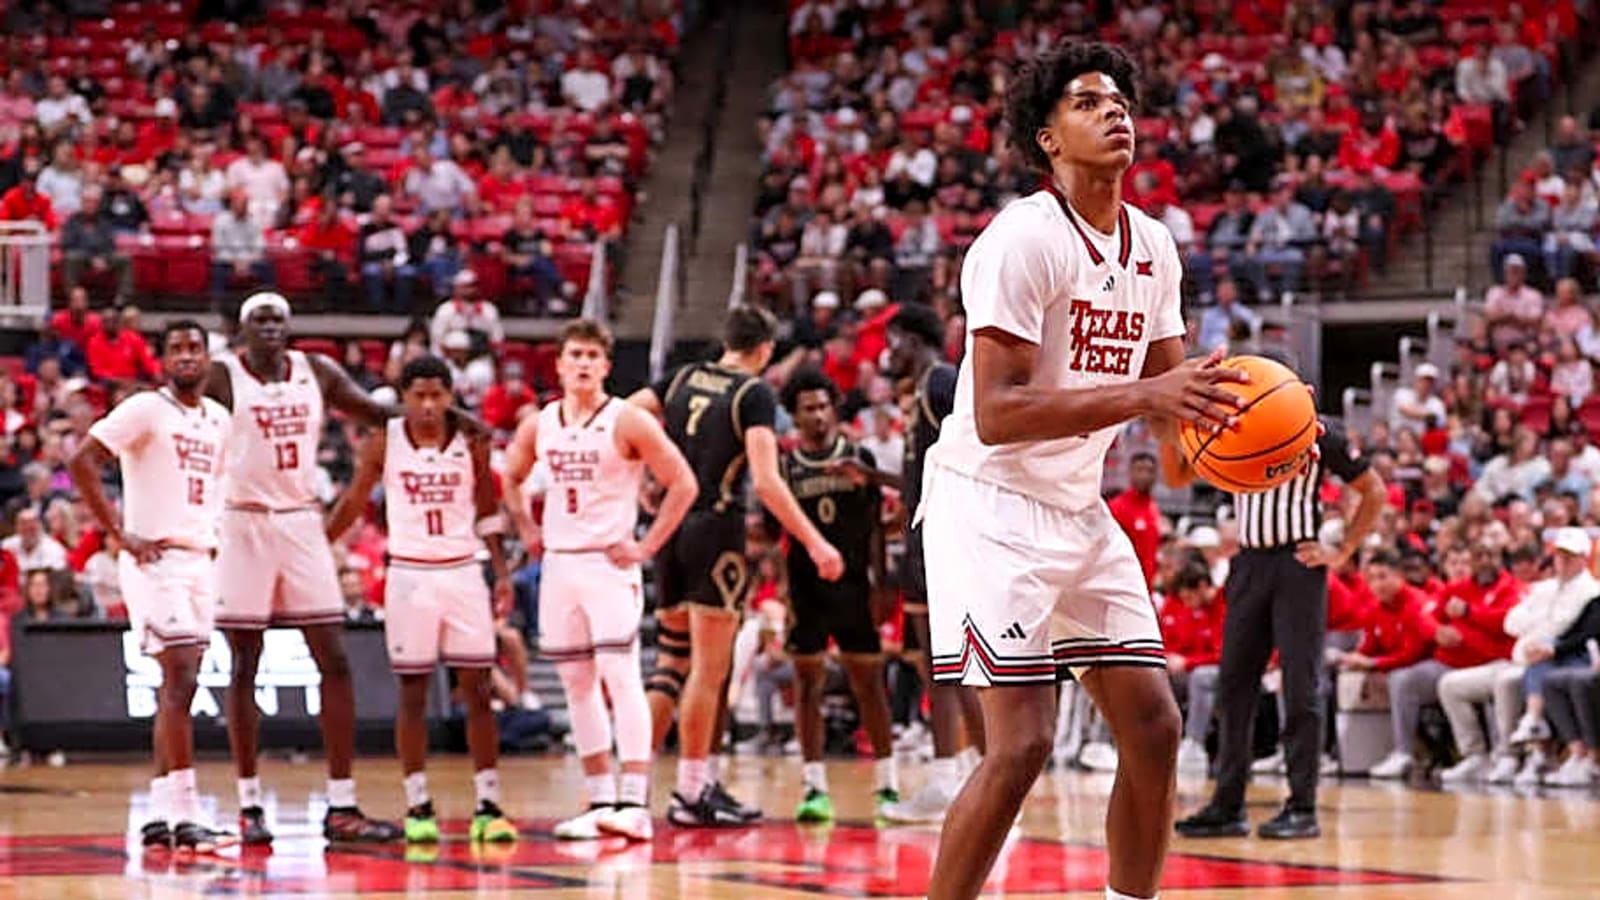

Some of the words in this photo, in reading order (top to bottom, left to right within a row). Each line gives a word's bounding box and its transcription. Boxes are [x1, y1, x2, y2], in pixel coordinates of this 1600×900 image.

[1069, 299, 1145, 342] TEXAS
[1070, 336, 1133, 375] TECH
[685, 395, 711, 436] 7
[275, 441, 299, 470] 13
[188, 476, 204, 505] 12
[425, 509, 443, 535] 11
[817, 497, 836, 524] 0
